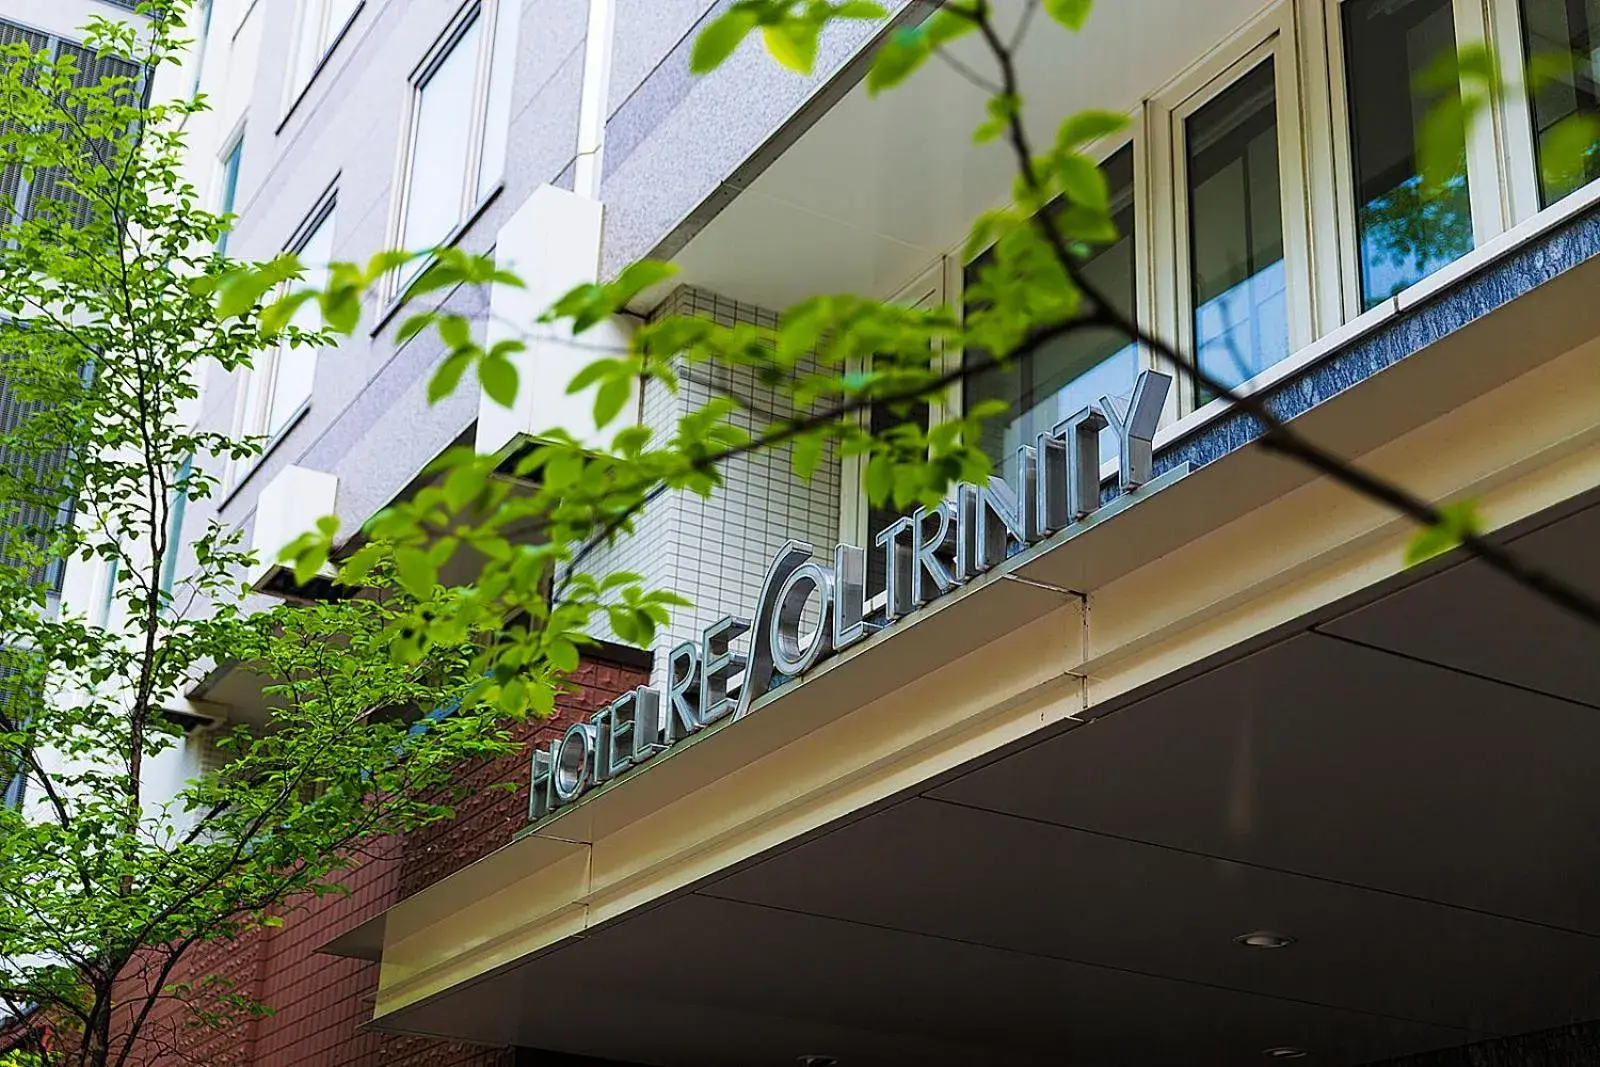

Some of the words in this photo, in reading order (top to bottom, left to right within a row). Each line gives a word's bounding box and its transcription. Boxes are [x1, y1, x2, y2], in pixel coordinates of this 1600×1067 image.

[528, 685, 668, 822] HOTEL
[664, 539, 880, 745] RESOL
[875, 369, 1172, 620] TRINITY
